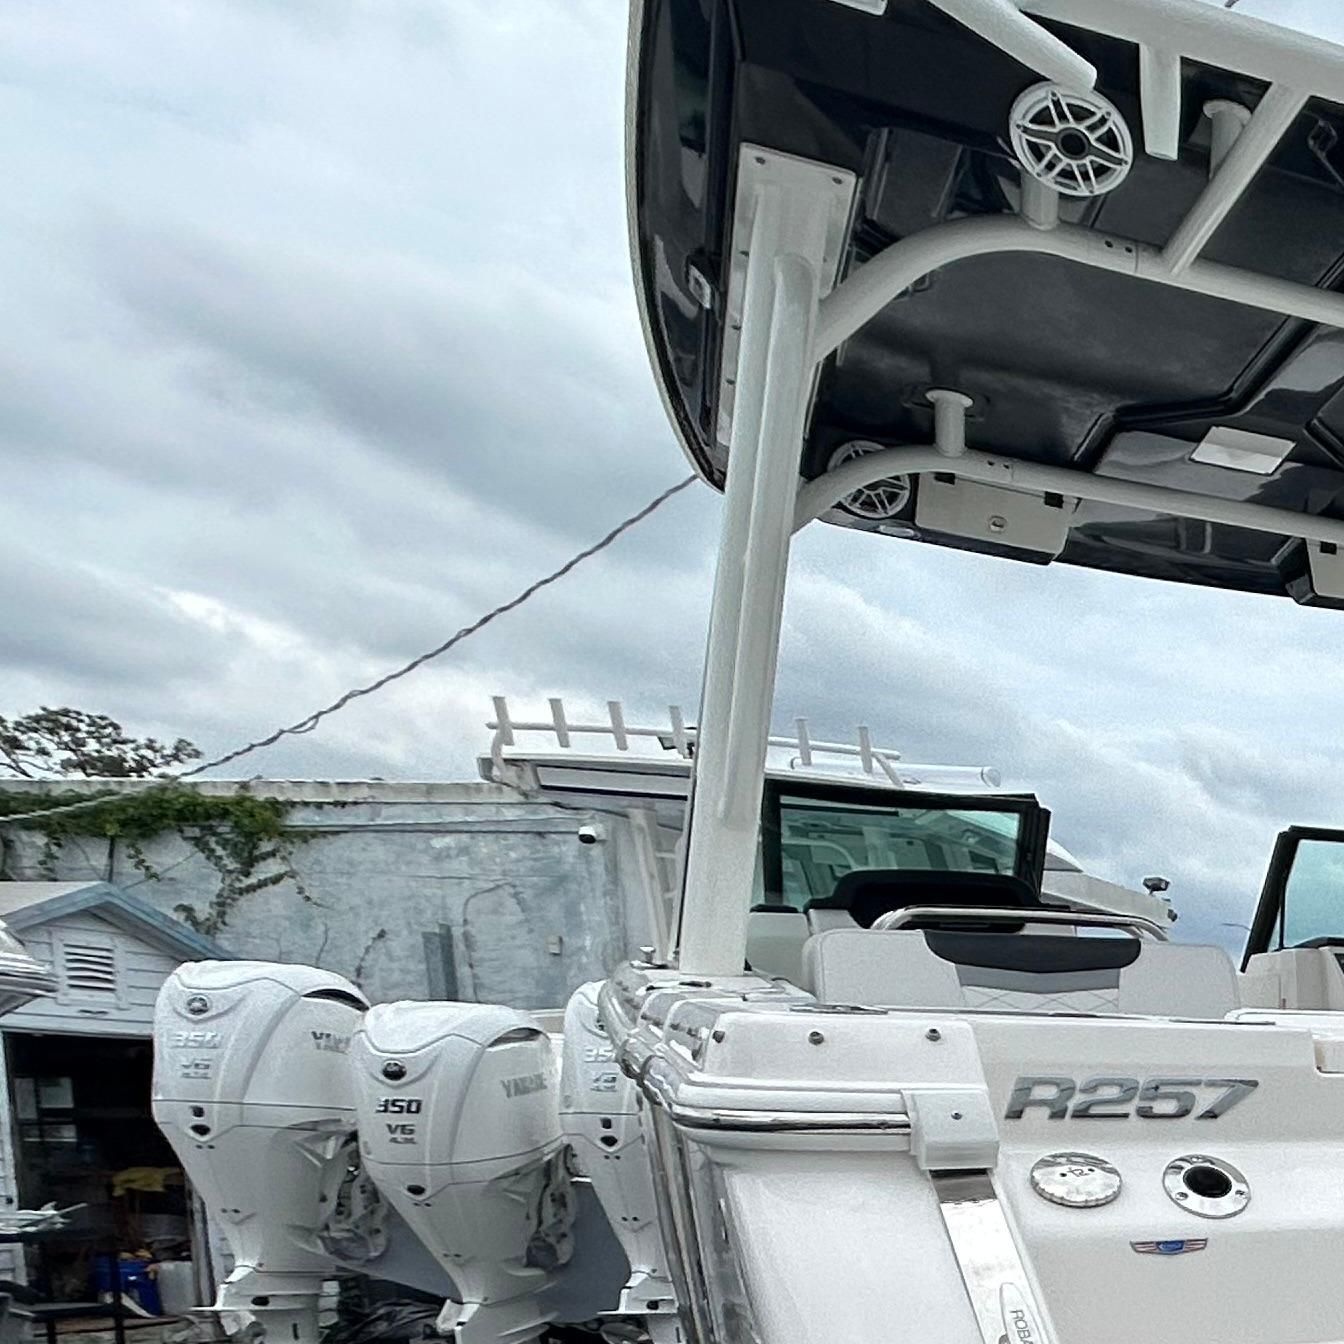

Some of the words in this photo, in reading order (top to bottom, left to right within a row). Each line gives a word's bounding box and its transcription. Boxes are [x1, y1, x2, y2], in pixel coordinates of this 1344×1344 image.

[1004, 1074, 1260, 1121] R257
[375, 1098, 423, 1115] 350
[386, 1123, 416, 1136] V6
